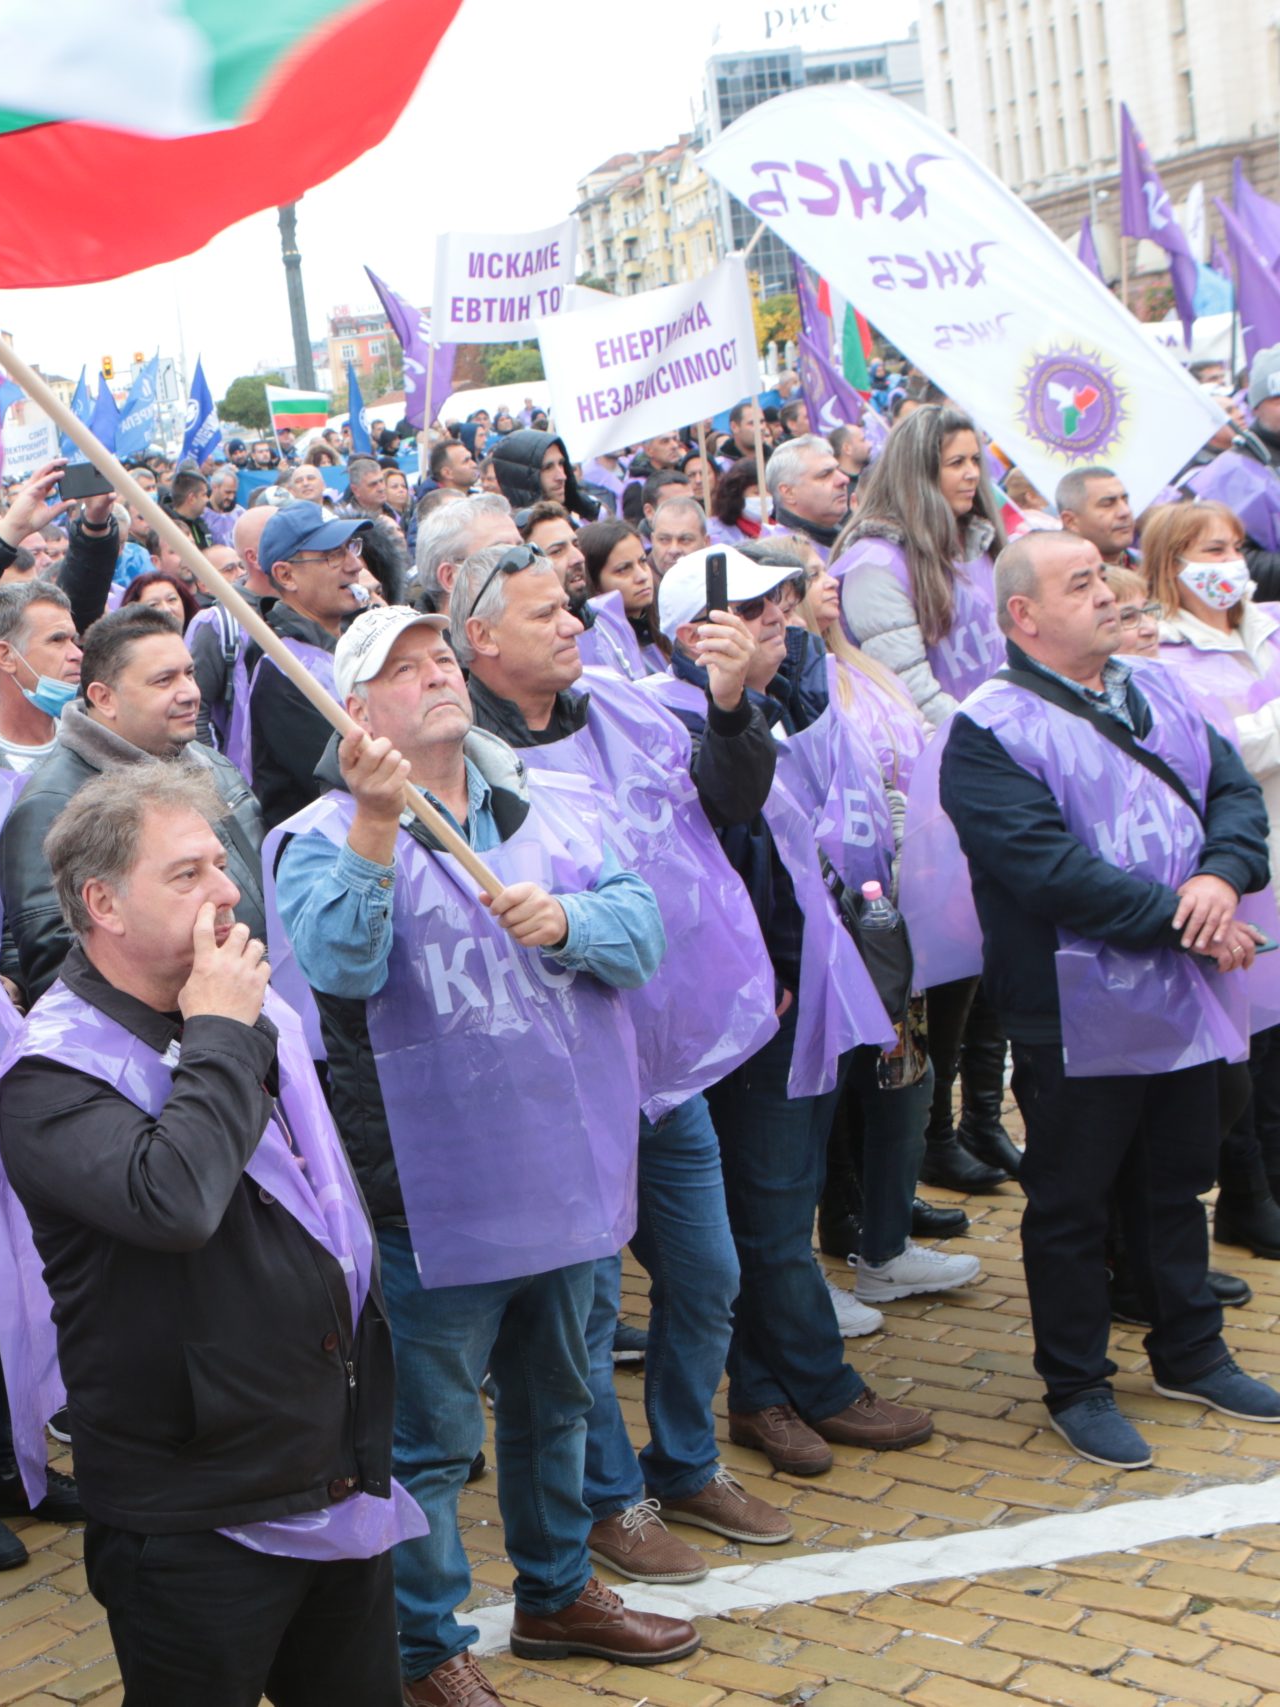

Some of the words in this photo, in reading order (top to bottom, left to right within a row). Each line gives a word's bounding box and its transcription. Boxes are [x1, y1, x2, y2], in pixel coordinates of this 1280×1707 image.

[765, 3, 837, 39] pwc
[468, 241, 560, 279] ИСКАМЕ
[450, 294, 530, 323] ЕВТИН
[537, 286, 563, 316] ТО
[595, 300, 712, 369] ЕНЕРГИЙНА
[577, 337, 738, 423] НЕЗАВИСИМОСТ
